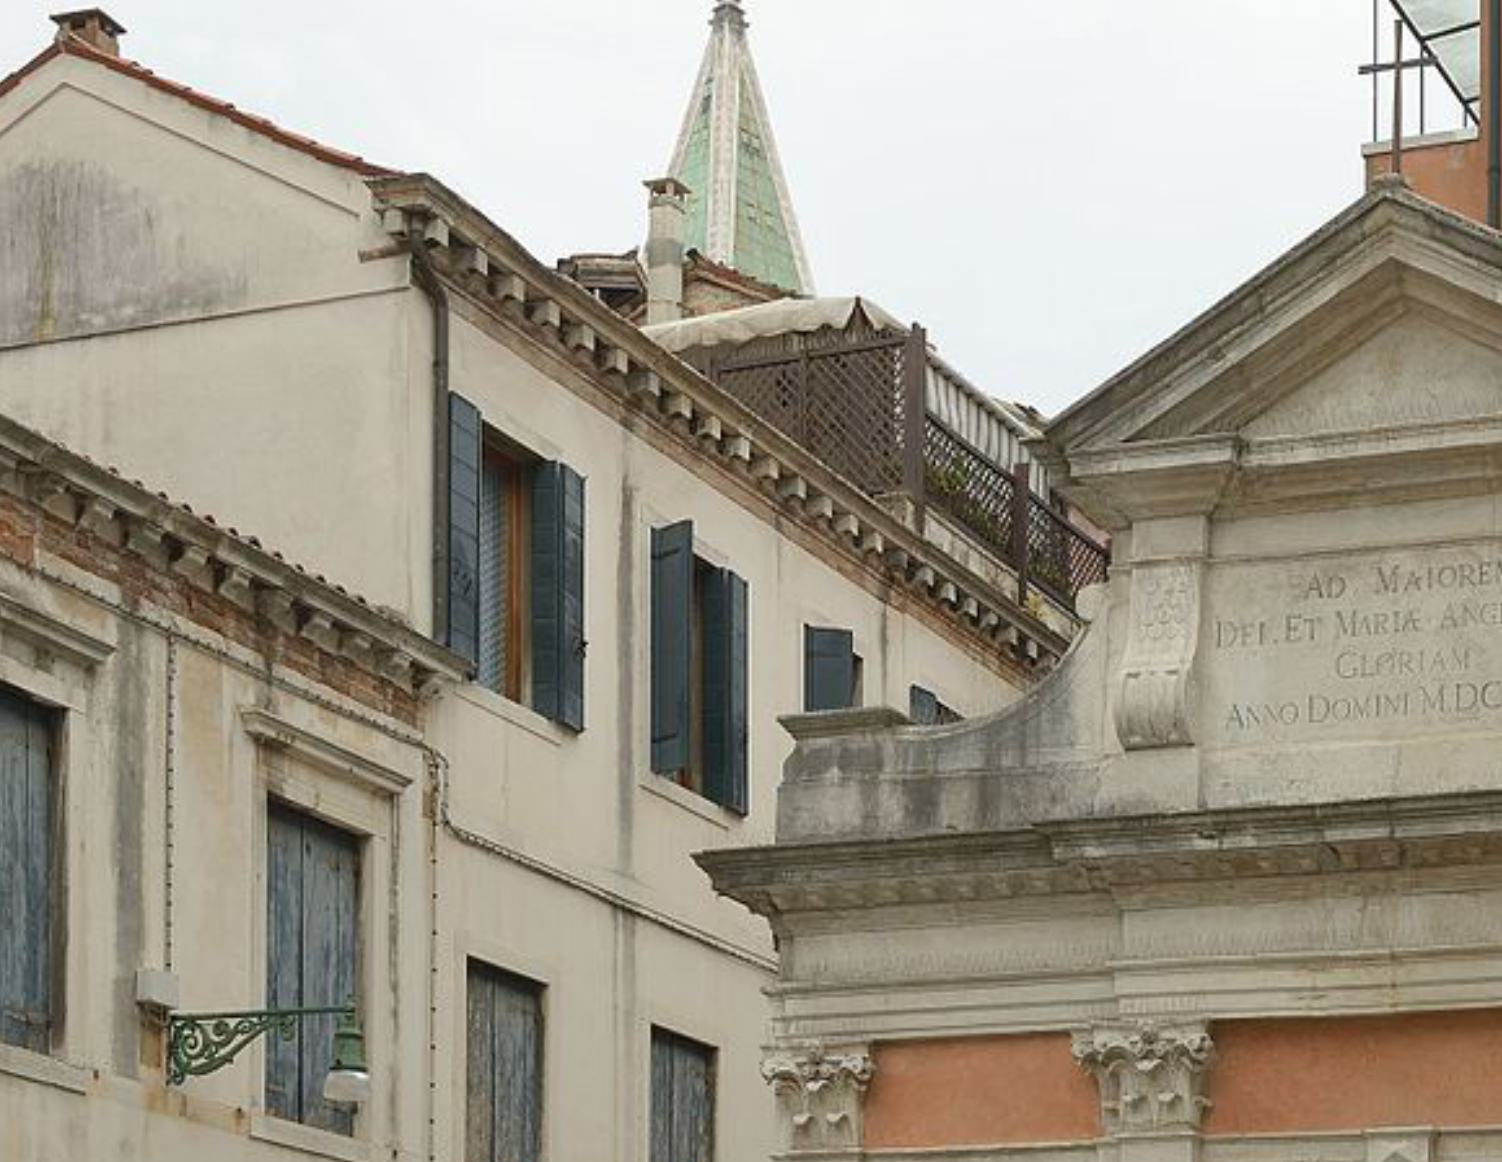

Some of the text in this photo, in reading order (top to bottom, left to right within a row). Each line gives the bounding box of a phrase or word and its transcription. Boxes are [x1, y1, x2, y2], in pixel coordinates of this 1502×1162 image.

[1303, 571, 1347, 600] AD
[1285, 612, 1319, 643] ET
[1335, 649, 1470, 680] GLORIAM
[1225, 702, 1300, 731] ANNO
